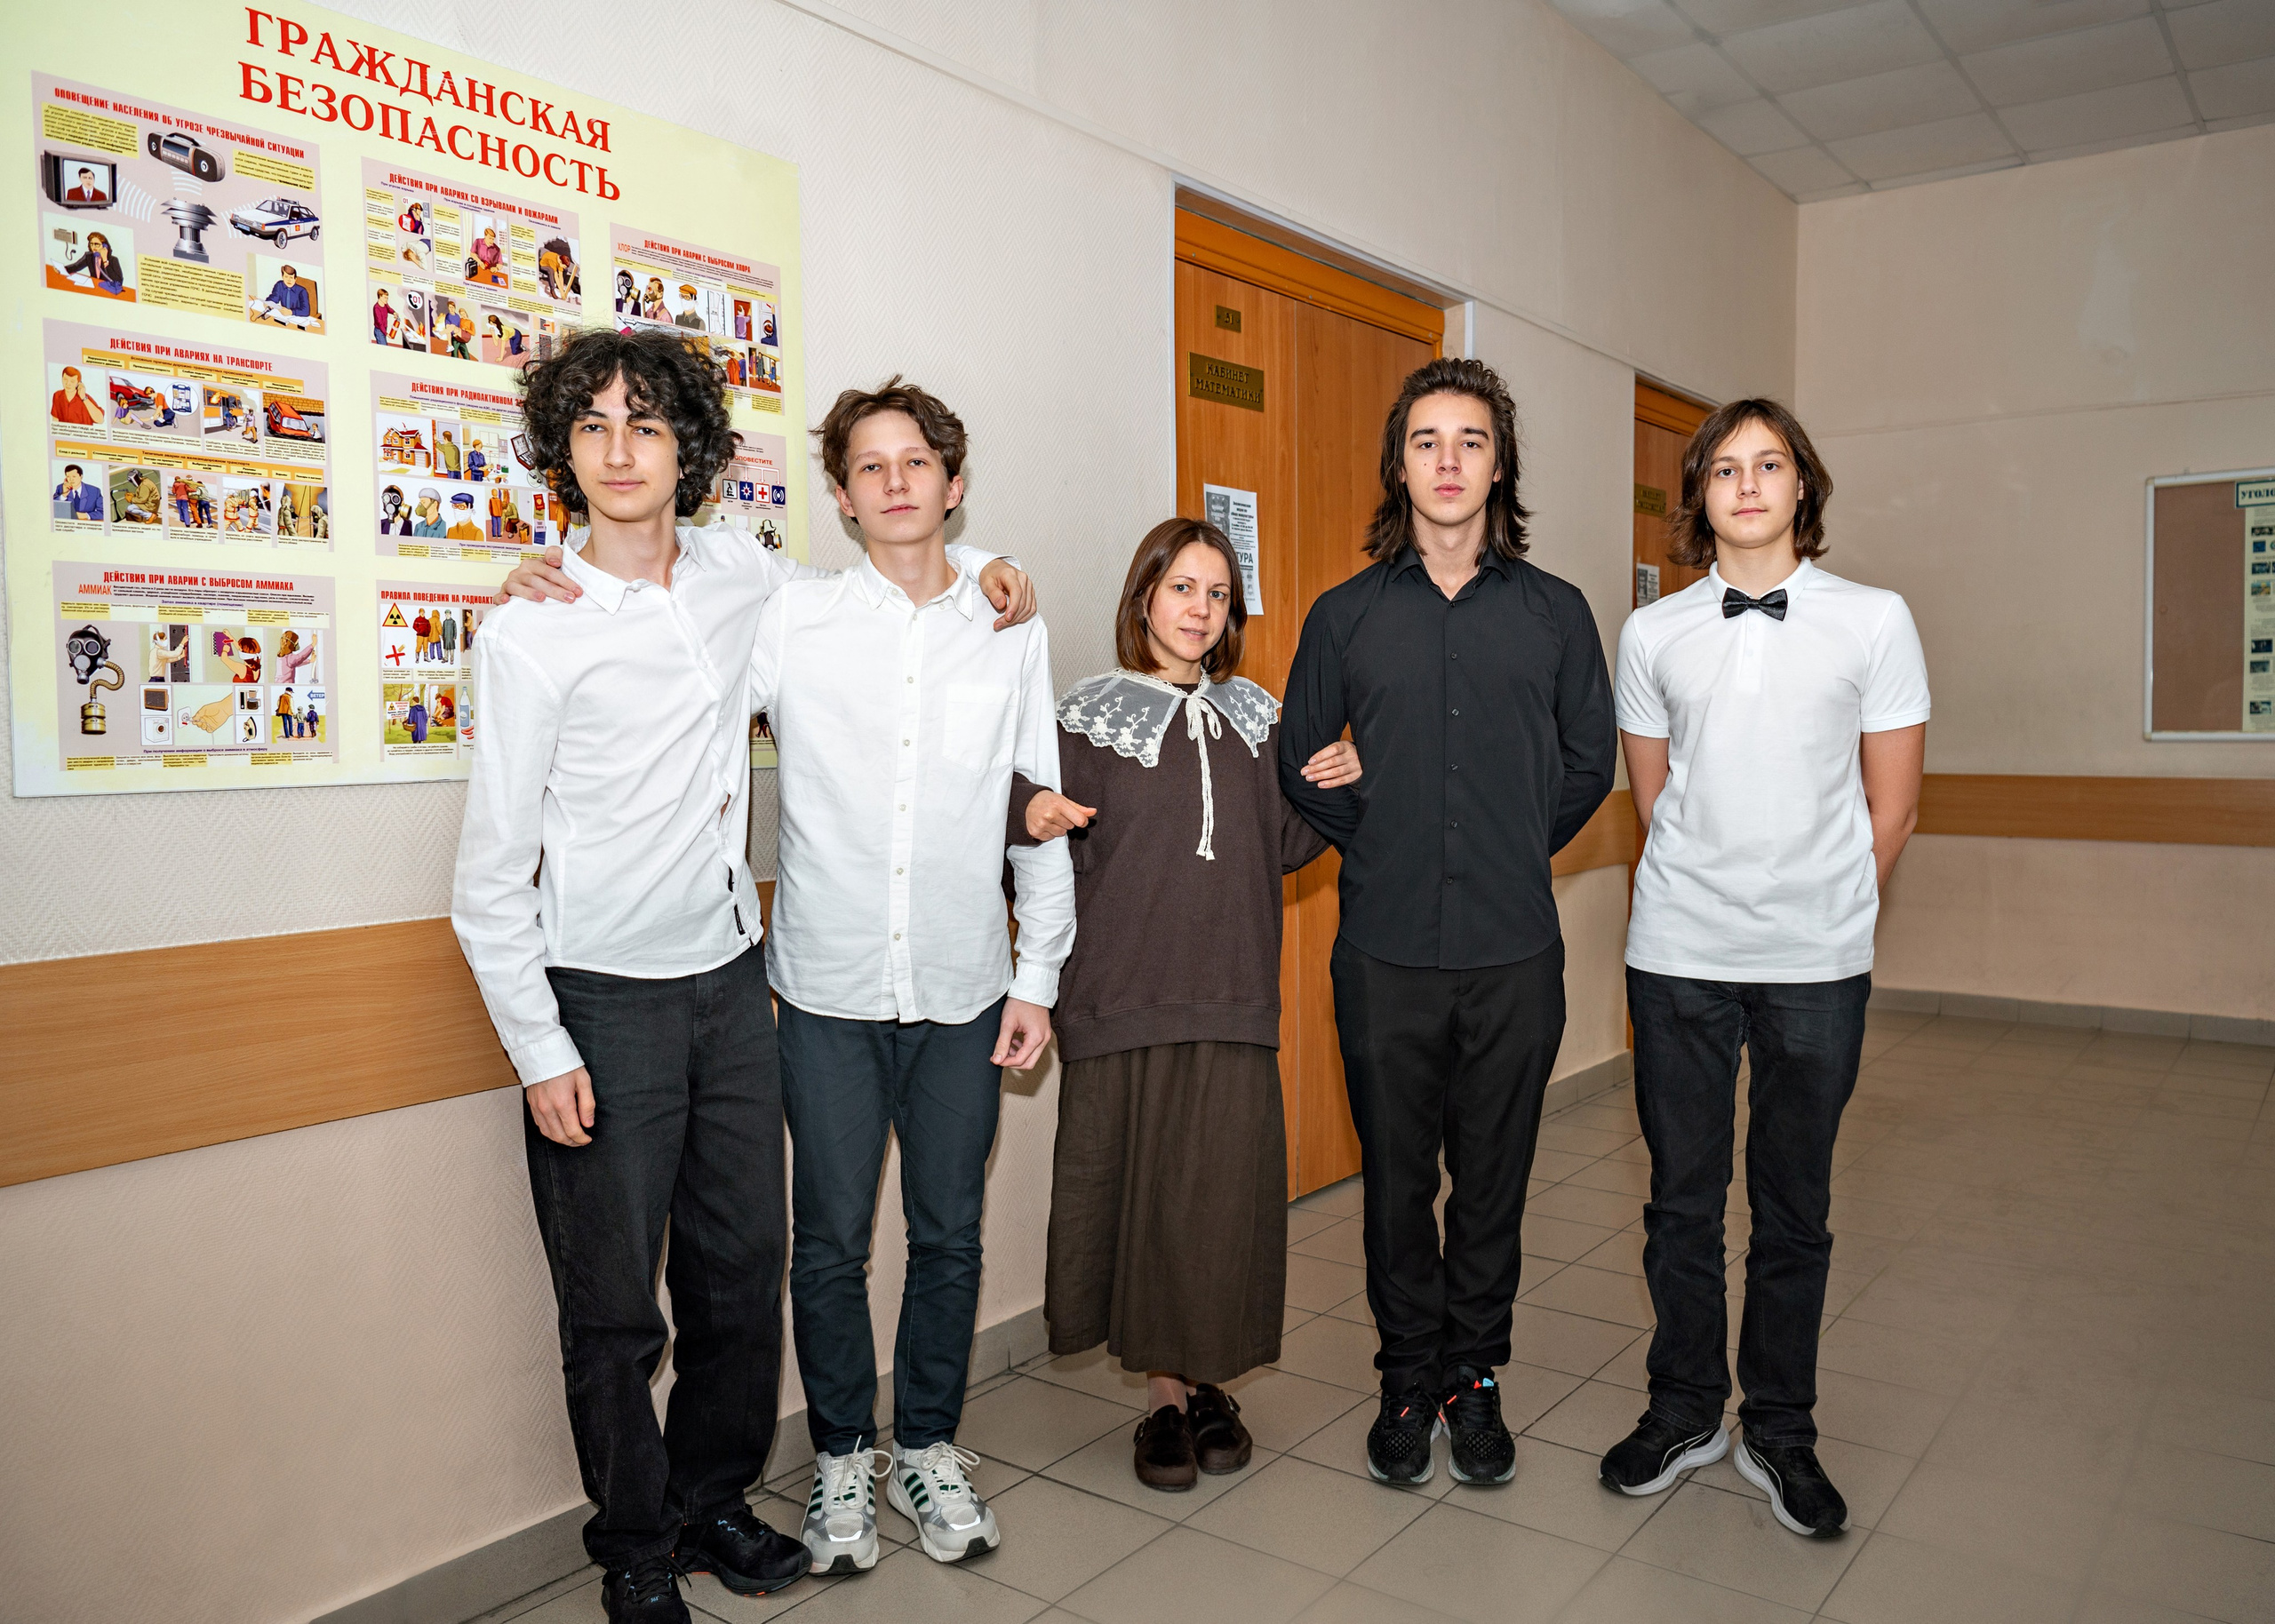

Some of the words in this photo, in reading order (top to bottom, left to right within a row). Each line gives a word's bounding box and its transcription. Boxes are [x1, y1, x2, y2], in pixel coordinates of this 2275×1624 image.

[244, 7, 611, 153] ГРАЖДАНСКАЯ
[54, 87, 109, 111] ОПОВЕЩЕНИЕ
[113, 102, 159, 123] НАСЕЛЕНИЯ
[163, 115, 172, 126] ОБ
[176, 118, 204, 134] УГРОЗЕ
[207, 124, 265, 149] ЧРЕЗВЫЧАЙНОЙ
[267, 141, 305, 161] СИТУАЦИИ
[238, 61, 620, 201] БЕЗОПАСНОСТЬ
[389, 171, 423, 191] ДЕЙСТВИЯ
[426, 182, 438, 194] ПРИ
[440, 187, 468, 201] АВАРИЯХ
[471, 195, 478, 203] СО
[482, 197, 515, 213] ВЗРЫВАМИ
[524, 209, 558, 224] ПОЖАРАМИ
[618, 242, 631, 253] ХЛОР
[643, 238, 669, 254] ДЕЙСТВИЯ
[672, 247, 681, 256] ПРИ
[682, 250, 701, 261] АВАРИИ
[703, 254, 706, 263] С
[708, 256, 734, 270] ВЫБРОСОМ
[736, 263, 751, 274] ХЛОРА
[109, 337, 151, 354] ДЕЙСТВИЯ
[155, 345, 171, 356] ПРИ
[174, 347, 210, 362] АВАРИЯХ
[213, 354, 223, 364] НА
[226, 355, 273, 371] ТРАНСПОРТЕ
[1207, 363, 1249, 384] КАБИНЕТ
[411, 381, 443, 397] ДЕЙСТВИЯ
[446, 388, 459, 398] ПРИ
[461, 390, 513, 407] РАДИОАКТИВНОМ
[1195, 378, 1260, 403] МАТЕМАТИКИ
[78, 584, 112, 595] АММИАК
[103, 570, 145, 585] ДЕЙСТВИЯ
[149, 574, 164, 584] ПРИ
[168, 575, 199, 585] АВАРИИ
[201, 577, 206, 586] С
[210, 577, 252, 588] ВЫБРОСОМ
[256, 580, 294, 591] АММИАКА
[381, 591, 411, 601] ПРАВИЛА
[413, 593, 449, 603] ПОВЕДЕНИЯ
[451, 594, 459, 603] НА
